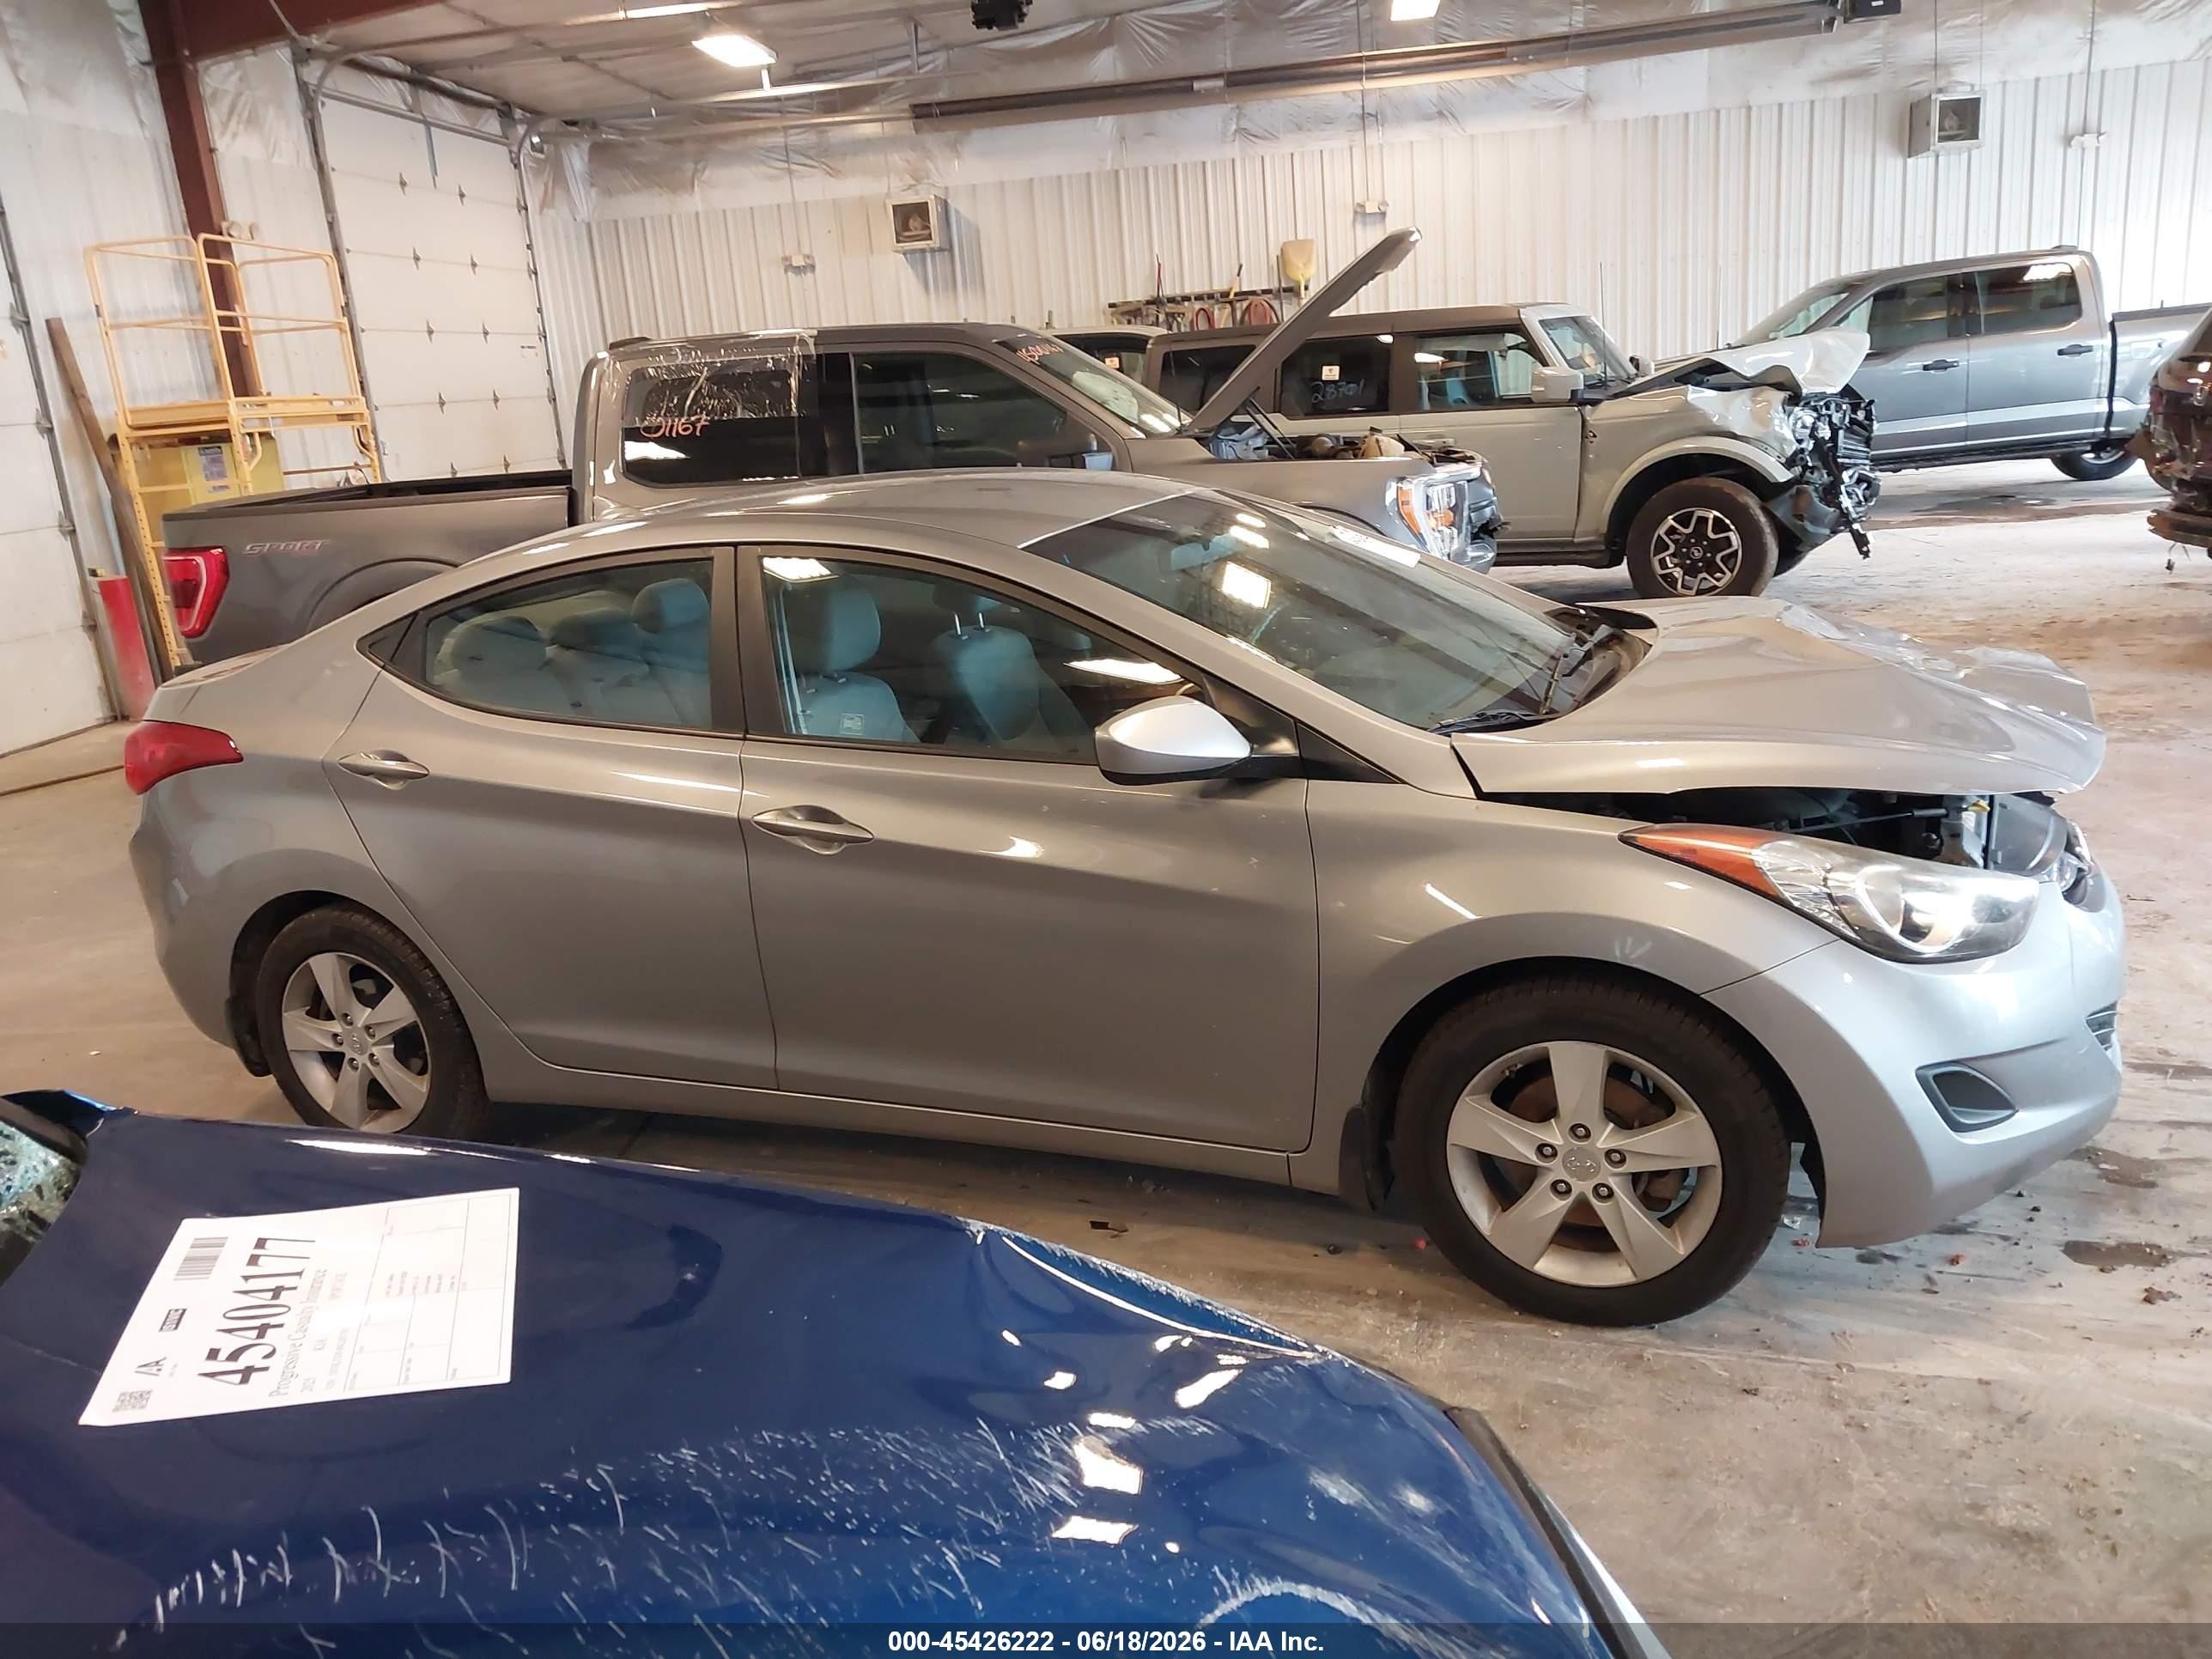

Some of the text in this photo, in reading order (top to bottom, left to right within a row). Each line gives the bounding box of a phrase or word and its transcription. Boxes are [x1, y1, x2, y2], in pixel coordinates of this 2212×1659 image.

[241, 539, 331, 556] SPORT
[197, 1237, 316, 1385] 45404177
[268, 1342, 303, 1397] Progressive
